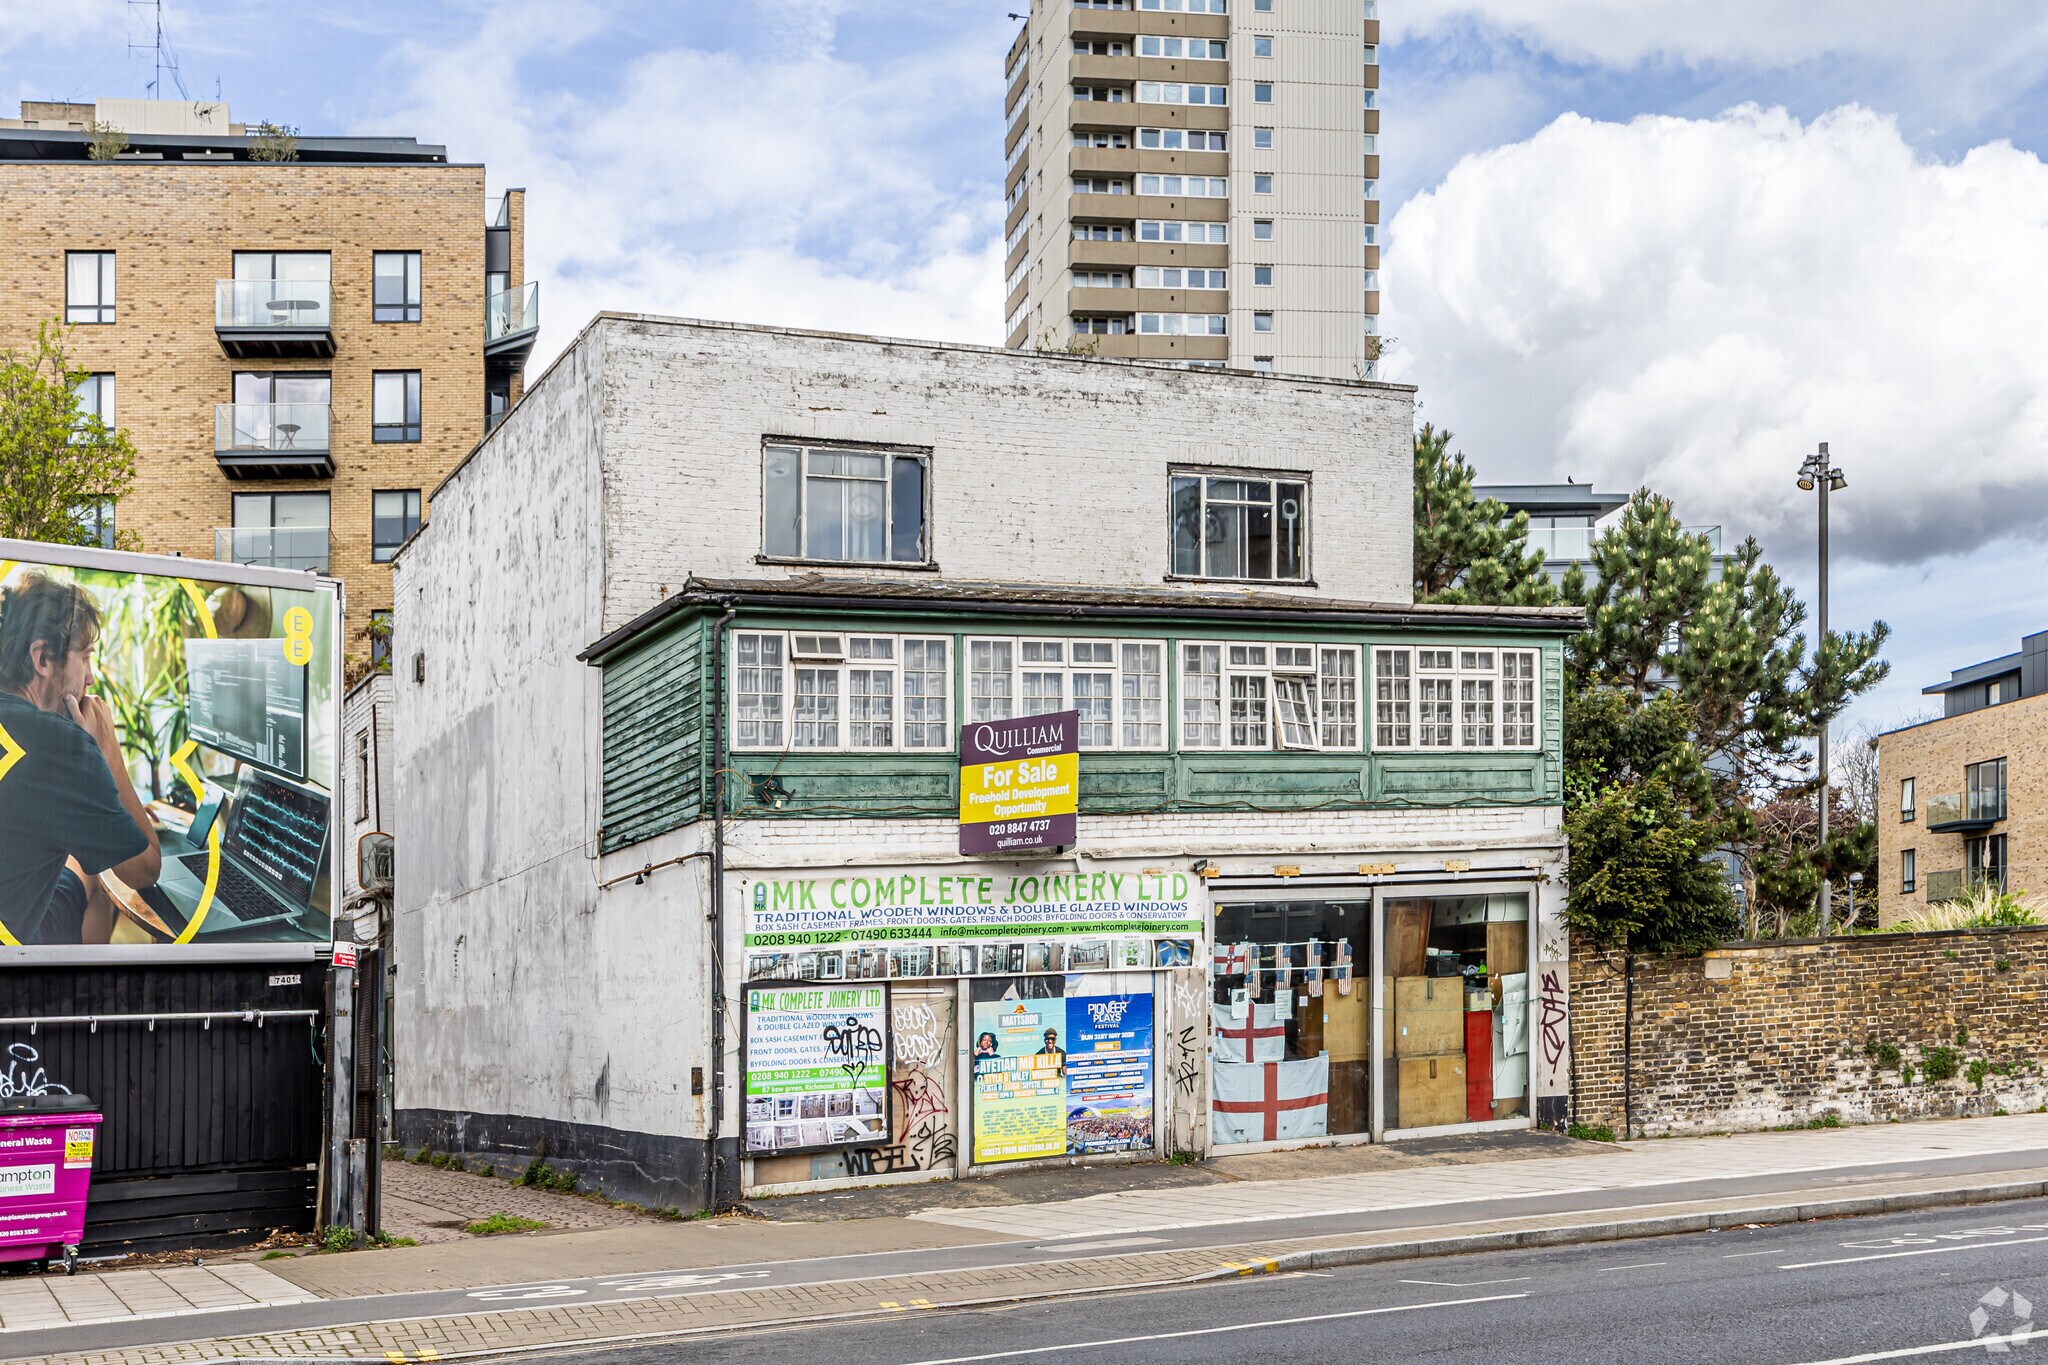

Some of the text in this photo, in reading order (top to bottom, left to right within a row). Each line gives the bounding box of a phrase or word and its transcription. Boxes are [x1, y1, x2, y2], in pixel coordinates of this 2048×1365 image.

[974, 723, 1064, 756] QUILLIAM
[1027, 743, 1062, 755] Commercial
[983, 760, 1057, 789] For Sale
[969, 784, 1070, 804] Freehold Development
[993, 801, 1047, 818] Opportunity
[989, 820, 1050, 836] 020 8847 4737
[997, 835, 1043, 848] quilliam.co.uk
[773, 873, 1188, 911] MK COMPLETE JOINERY LTD
[754, 902, 766, 910] MK
[754, 902, 1188, 923] TRADITIONAL WOODEN WINDOWS & DOUBLE GLAZED WINDOWS
[755, 924, 774, 932] BOX
[776, 922, 799, 931] SASH
[801, 920, 847, 930] CASEMENT
[849, 917, 885, 927] FRAMES,
[887, 917, 914, 925] FRONT
[980, 914, 1017, 923] FRENCH
[1046, 912, 1088, 921] BYFOLDING
[1089, 912, 1117, 920] DOORS
[1125, 911, 1187, 920] CONSERVATORY
[754, 934, 785, 946] 0208
[788, 933, 811, 945] 940
[815, 932, 841, 944] 1222
[851, 929, 887, 941] 07490
[890, 927, 933, 940] 633444
[940, 925, 1065, 937] info@mkcompletejoinery.com
[1071, 923, 1189, 934] www.mkcompletejoinery.com
[275, 976, 296, 984] 7401
[762, 989, 881, 1011] MK COMPLETE JOINERY LTD
[1088, 1001, 1127, 1015] PIONEER
[757, 1011, 874, 1023] TRADITIONAL WOODEN WINDOWS
[1001, 1014, 1039, 1027] MATTSBBQ
[1093, 1013, 1121, 1023] PLAYS
[764, 1022, 792, 1031] DOUBLE
[793, 1021, 820, 1030] GLAZED
[822, 1019, 857, 1029] WINDO
[786, 1034, 817, 1042] CASEMENT
[750, 1048, 772, 1056] FRONT
[774, 1047, 799, 1055] DOORS,
[789, 1058, 811, 1066] DOORS
[980, 1053, 1061, 1074] AYETIAN MR KILLA
[752, 1072, 772, 1081] 0208
[774, 1071, 789, 1079] 940
[791, 1070, 811, 1078] 1222
[819, 1068, 844, 1077] 07490
[1011, 1071, 1030, 1082] WILEY
[785, 1085, 804, 1094] green,
[805, 1083, 835, 1091] Richmond
[25, 1137, 53, 1146] Waste
[68, 1131, 79, 1141] NO
[25, 1182, 51, 1191] Waste
